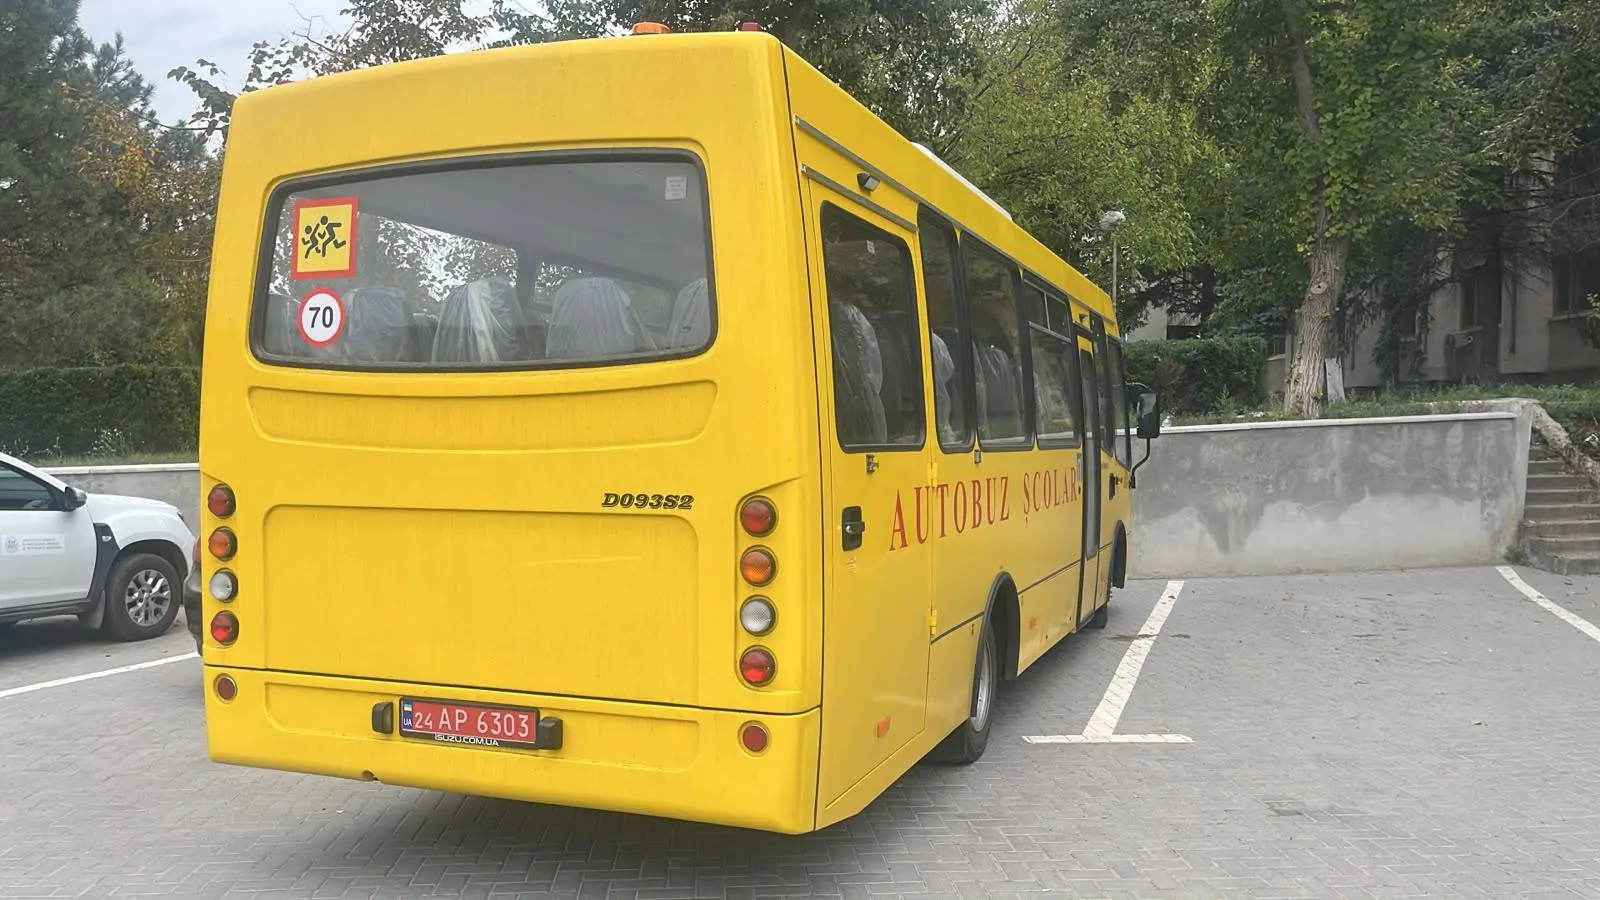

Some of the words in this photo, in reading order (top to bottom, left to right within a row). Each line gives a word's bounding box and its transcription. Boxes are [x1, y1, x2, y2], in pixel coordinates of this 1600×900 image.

[308, 306, 334, 329] 70
[601, 493, 694, 510] D093S2
[889, 476, 1009, 550] AUTOBUZ
[1023, 467, 1077, 527] ȘCOLAR
[403, 717, 412, 726] UA
[414, 712, 433, 730] 24
[438, 708, 468, 731] AP
[477, 711, 529, 738] 6303
